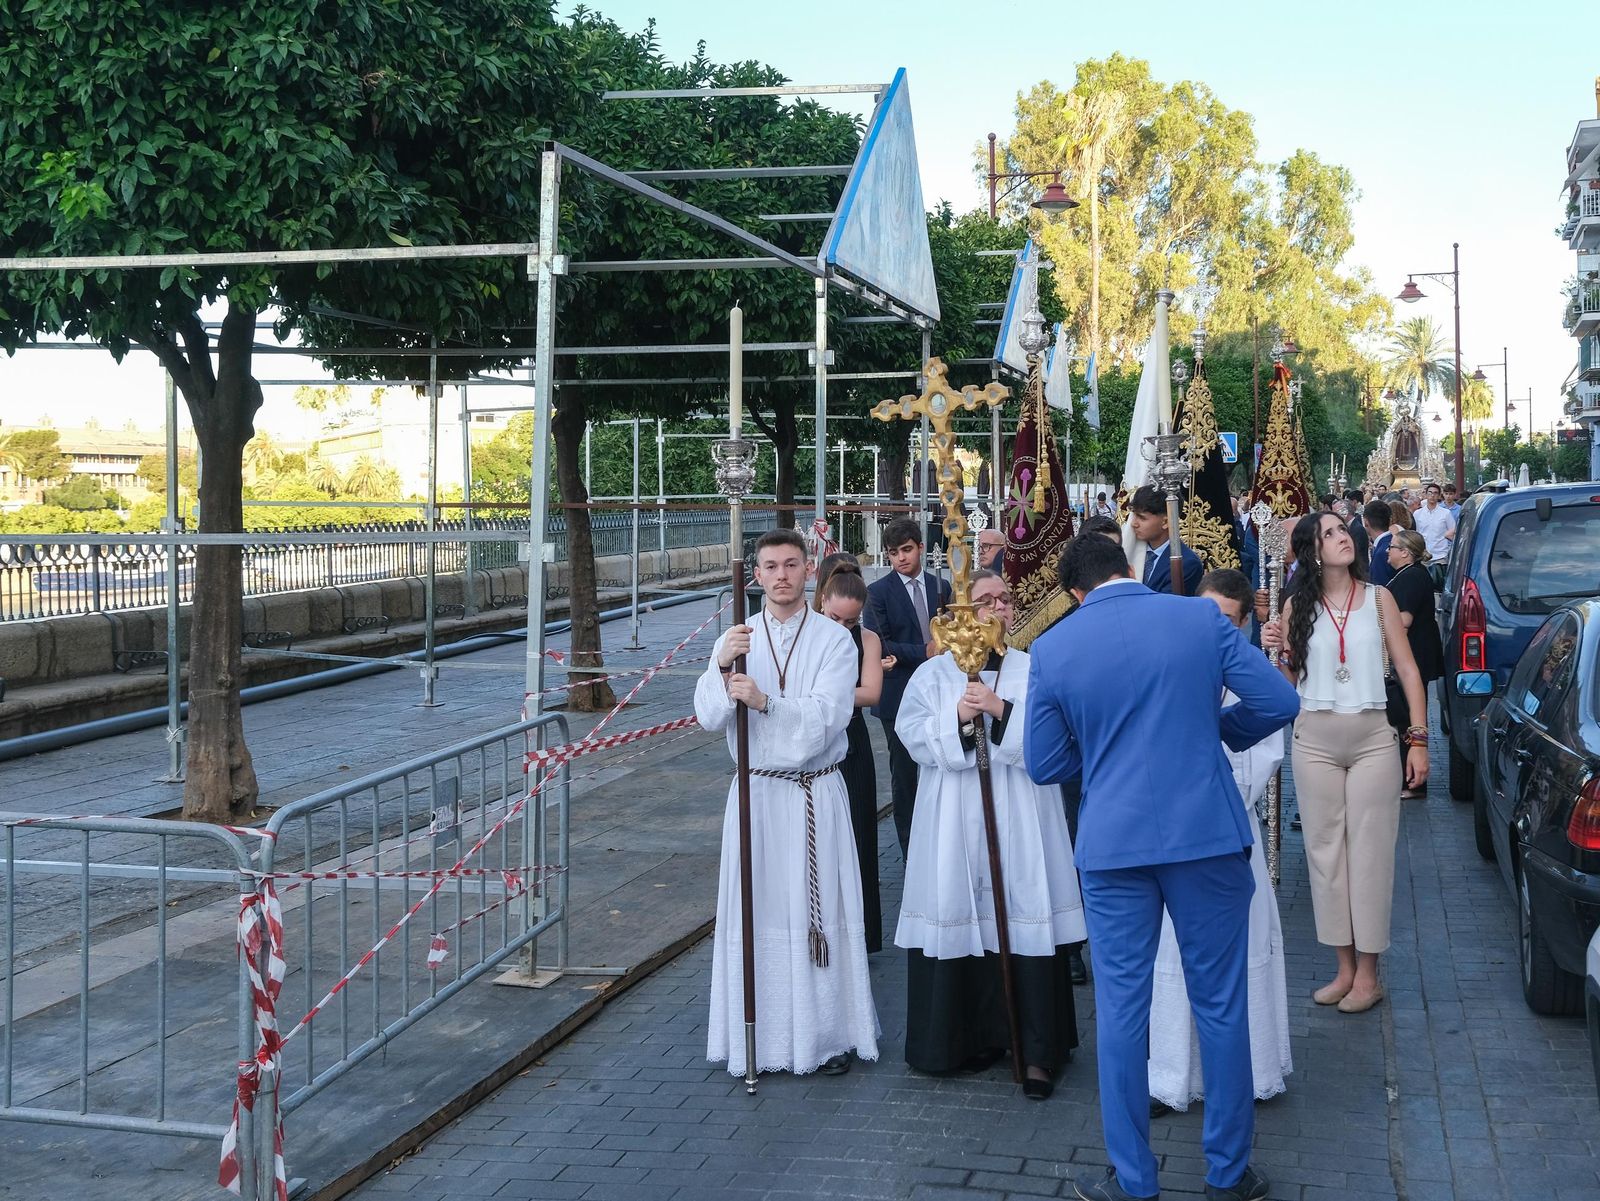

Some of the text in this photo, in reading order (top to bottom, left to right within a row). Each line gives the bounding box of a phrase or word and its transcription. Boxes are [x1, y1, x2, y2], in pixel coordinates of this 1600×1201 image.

[1006, 508, 1070, 562] DE SAN GONZALO
